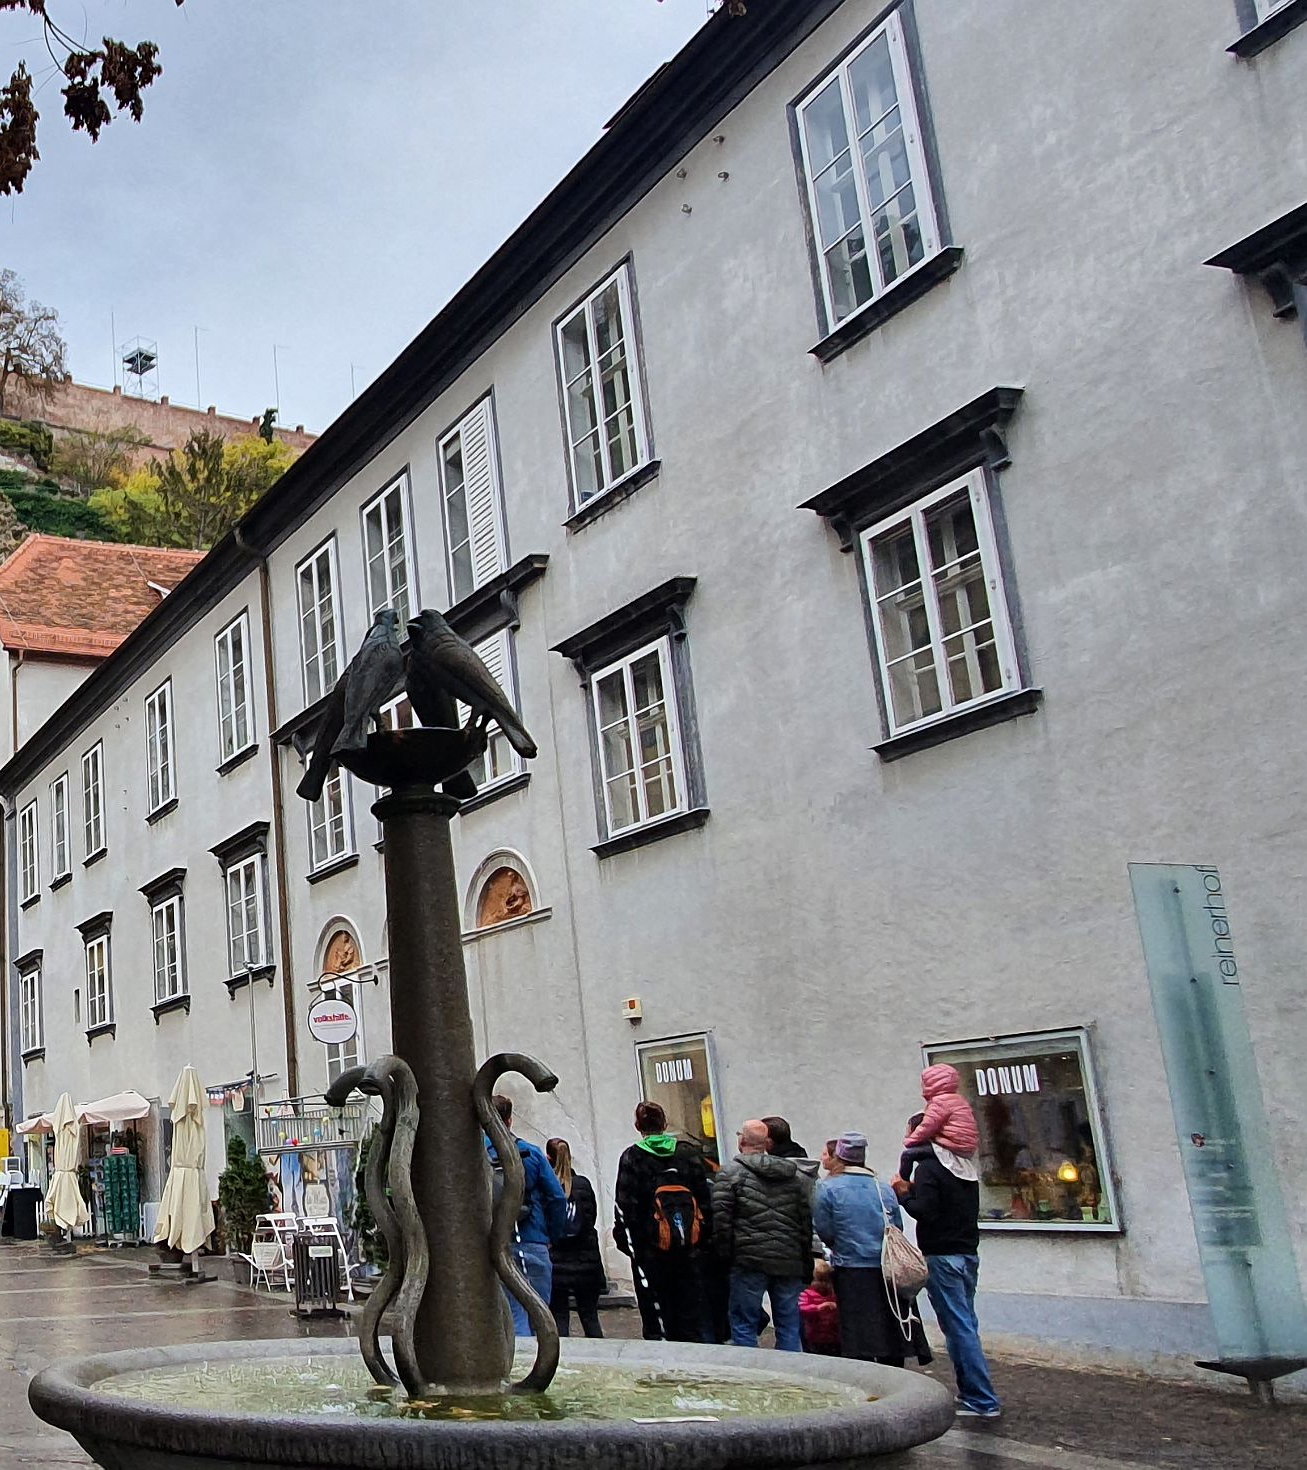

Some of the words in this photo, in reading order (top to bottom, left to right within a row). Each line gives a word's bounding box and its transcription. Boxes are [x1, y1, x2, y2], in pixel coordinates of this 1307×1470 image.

[1194, 864, 1239, 985] reinerhof
[655, 1058, 693, 1083] DONUM
[975, 1064, 1040, 1096] DONUM
